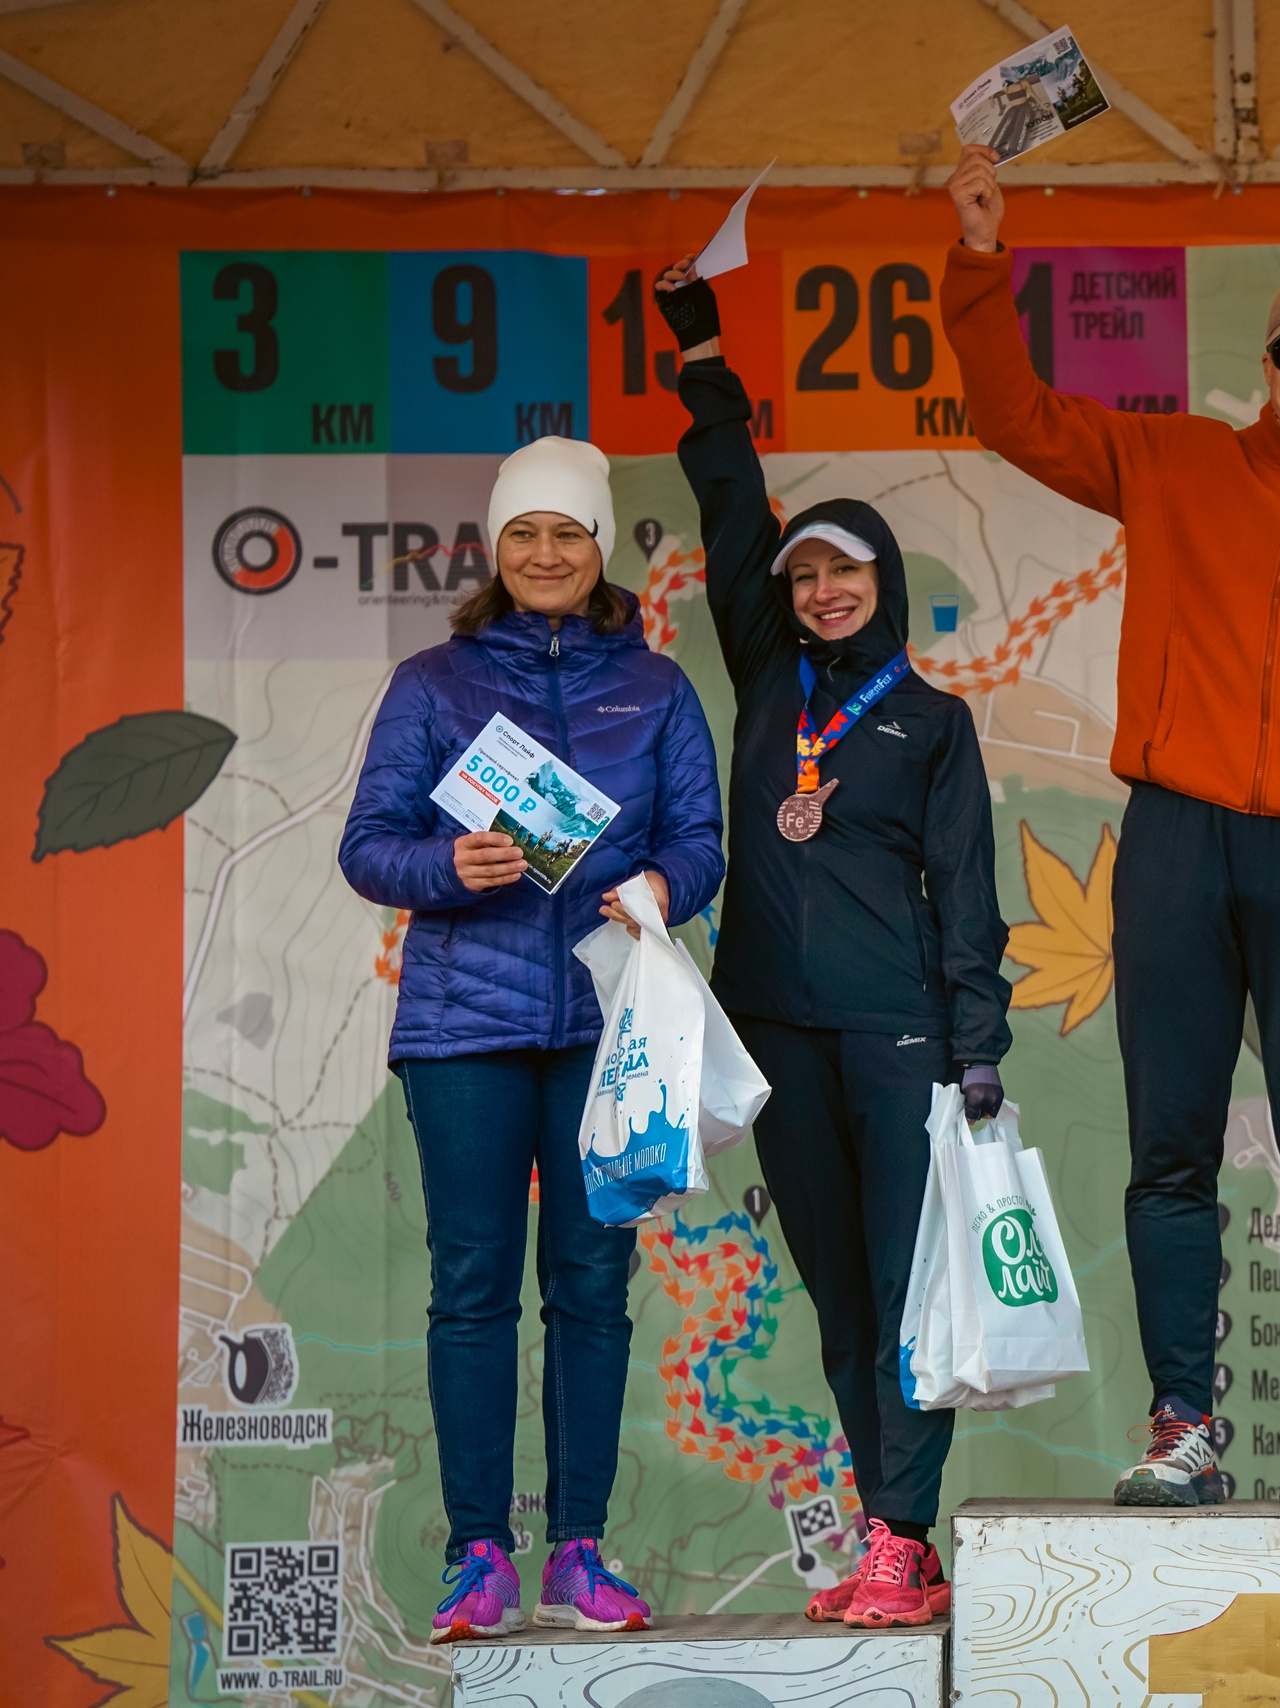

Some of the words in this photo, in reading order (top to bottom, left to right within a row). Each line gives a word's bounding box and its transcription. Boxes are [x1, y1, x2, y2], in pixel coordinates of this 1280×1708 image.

[1070, 265, 1178, 305] ДЕТСКИЙ
[212, 262, 280, 394] 3
[431, 263, 499, 394] 9
[794, 262, 935, 392] 26
[1015, 262, 1055, 392] 1
[1071, 306, 1144, 341] ТРЕЙЛ
[311, 403, 375, 445] КМ
[514, 402, 574, 444] КМ
[645, 521, 656, 548] 3
[605, 705, 640, 713] Columbia
[501, 730, 520, 746] Спорт
[518, 743, 536, 759] Лайф
[876, 724, 908, 740] DEMIX
[477, 747, 497, 764] Призовой
[495, 761, 520, 782] сертификат
[785, 812, 804, 828] Fe
[804, 810, 814, 819] 26
[896, 1036, 927, 1046] DEMIX
[634, 1142, 667, 1172] МОЛОКО
[751, 1188, 761, 1212] 1
[1214, 1365, 1225, 1386] 4
[181, 1408, 328, 1443] Железноводск
[1214, 1419, 1226, 1445] 5
